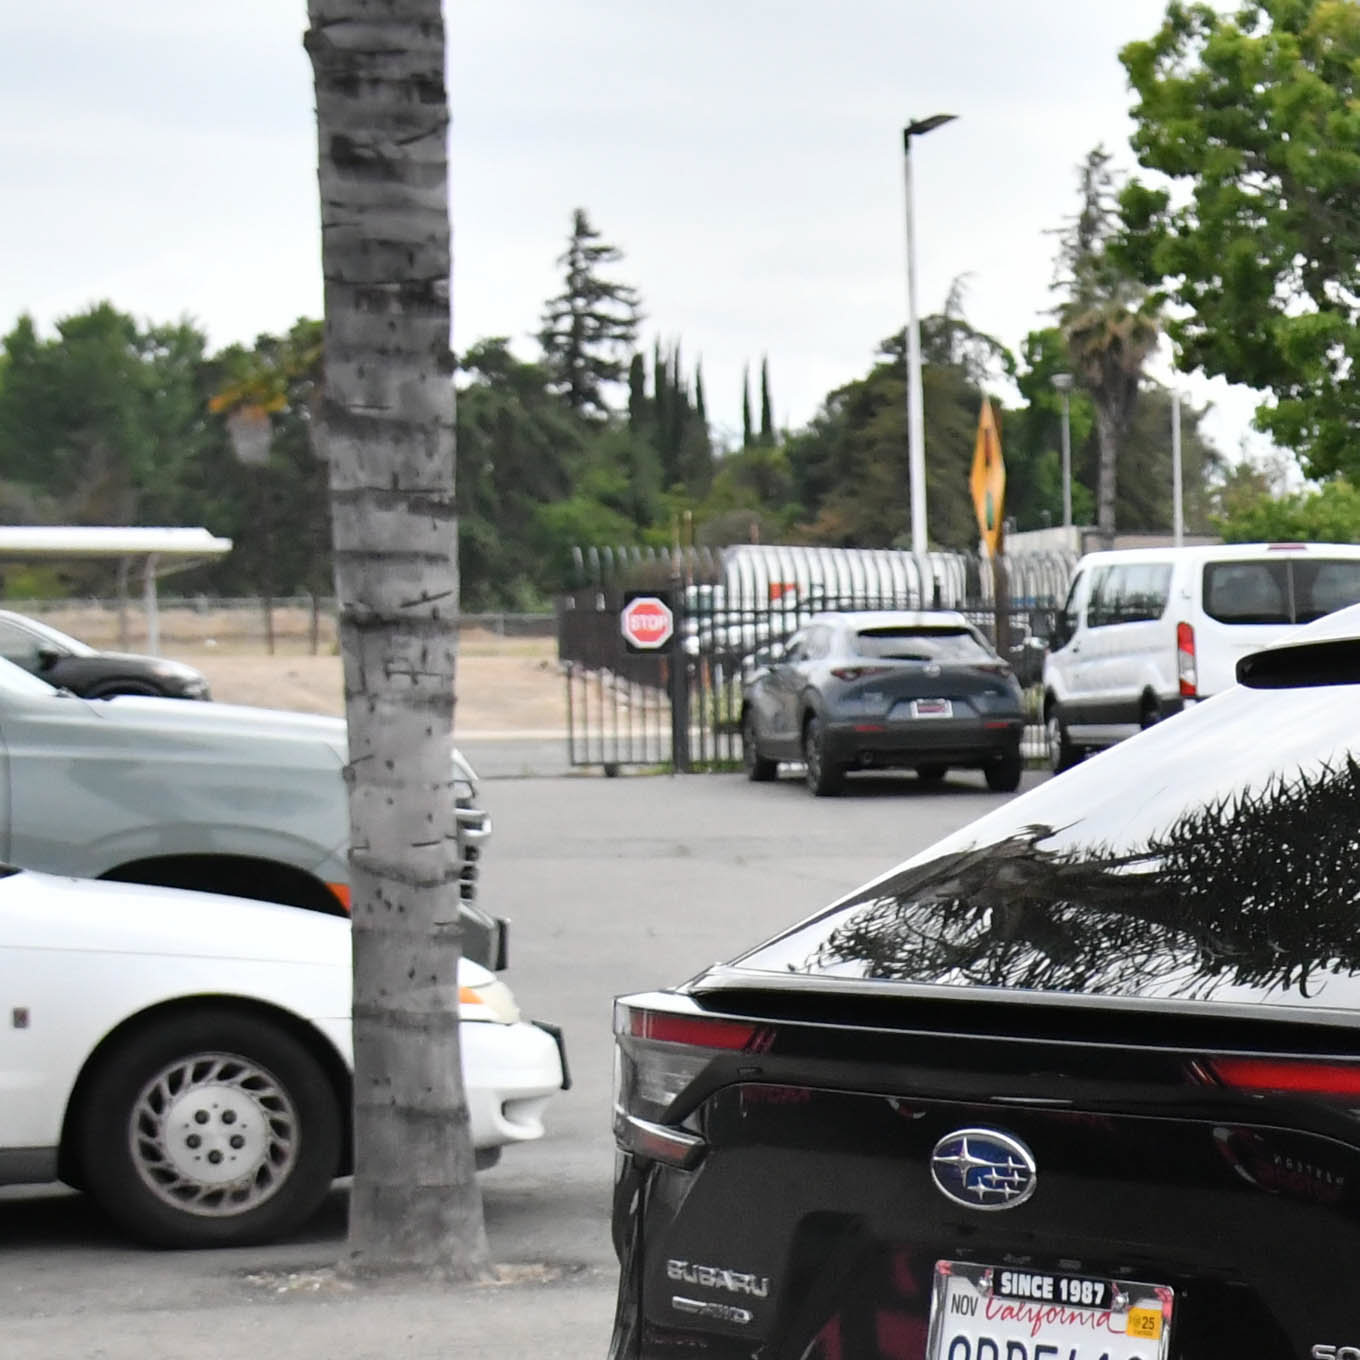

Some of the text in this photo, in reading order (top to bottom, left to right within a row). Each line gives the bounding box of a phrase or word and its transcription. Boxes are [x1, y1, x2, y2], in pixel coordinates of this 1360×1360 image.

[631, 614, 668, 631] STOP
[666, 1259, 769, 1297] SUBARU
[1000, 1271, 1105, 1305] SINCE 1987
[951, 1294, 979, 1317] NOV
[985, 1297, 1126, 1337] California
[1141, 1315, 1155, 1330] 25
